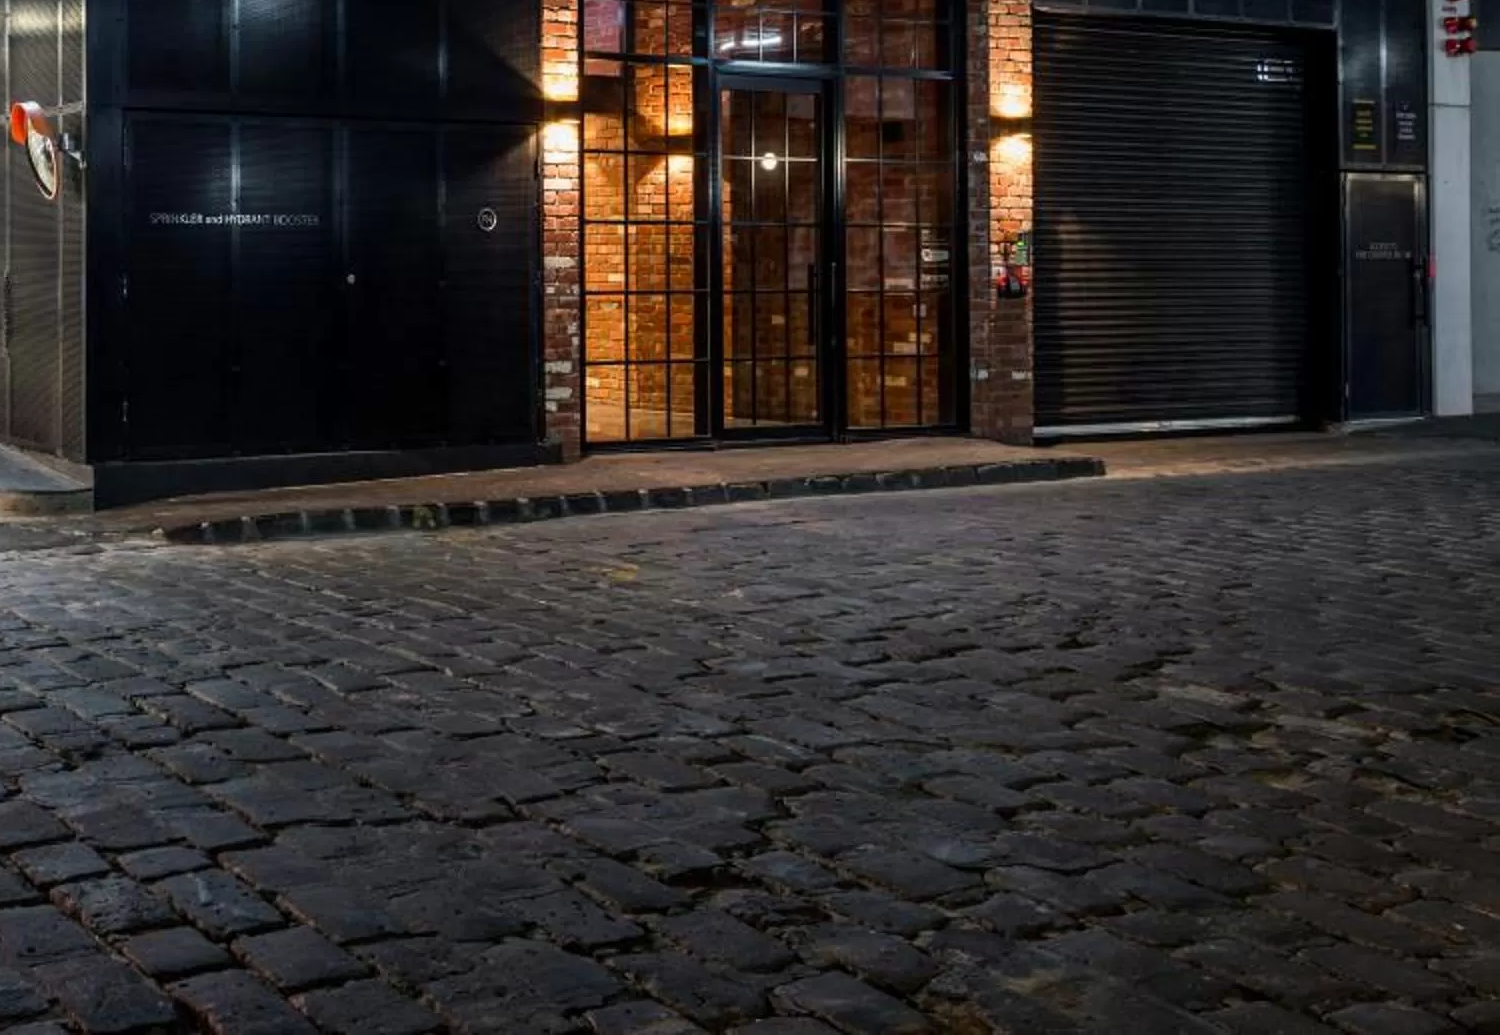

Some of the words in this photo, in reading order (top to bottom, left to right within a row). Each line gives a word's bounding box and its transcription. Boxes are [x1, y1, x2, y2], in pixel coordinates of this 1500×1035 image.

[150, 212, 203, 225] SPRINKLER
[205, 214, 223, 225] and
[225, 213, 271, 226] HYDRANT
[273, 214, 318, 226] BOOSTER
